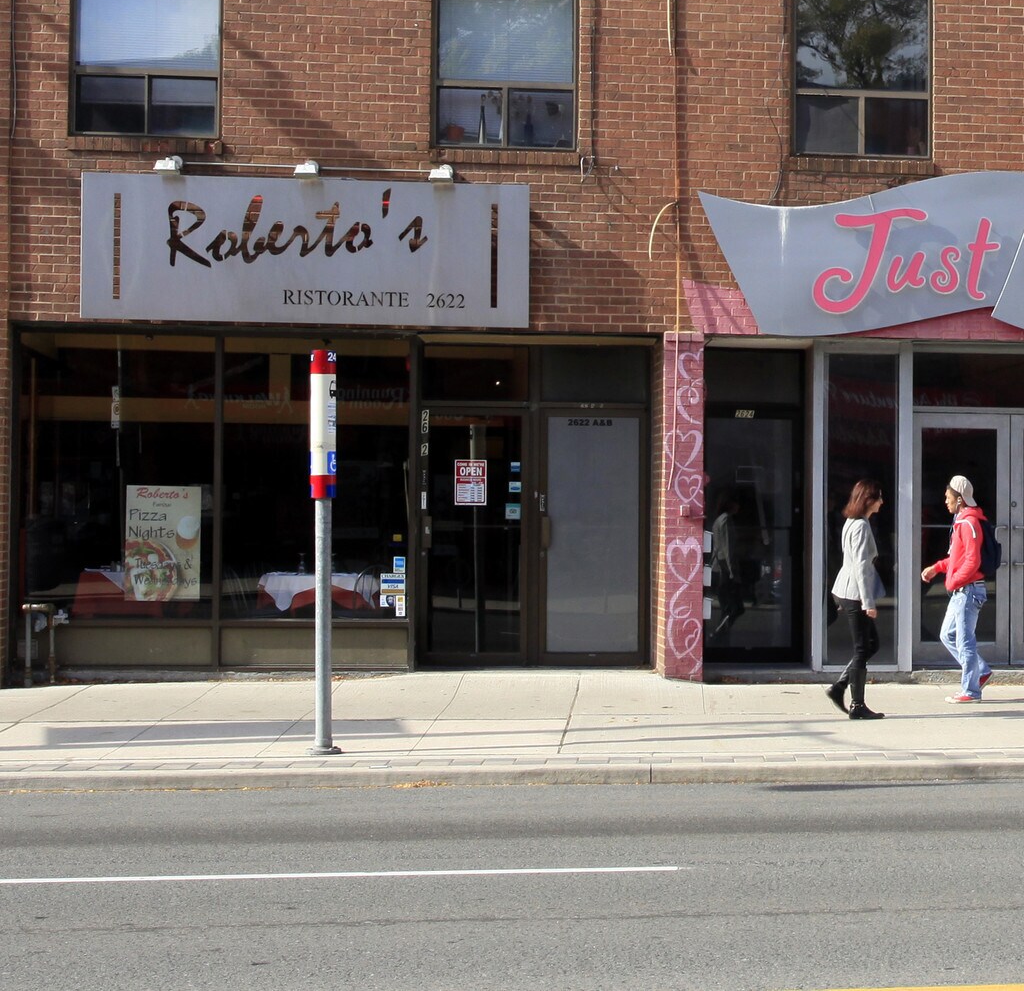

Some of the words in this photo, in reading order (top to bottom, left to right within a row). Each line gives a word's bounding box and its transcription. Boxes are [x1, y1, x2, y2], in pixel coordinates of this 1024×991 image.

[167, 188, 428, 268] Roberto's
[812, 208, 1000, 315] Just
[283, 290, 409, 307] RISTORANTE
[426, 293, 466, 309] 2622
[592, 419, 612, 427] A&B
[460, 467, 482, 476] OPEN
[136, 487, 188, 499] Roberto's
[129, 509, 167, 521] Pizza
[128, 526, 175, 540] Nights
[184, 558, 192, 569] &
